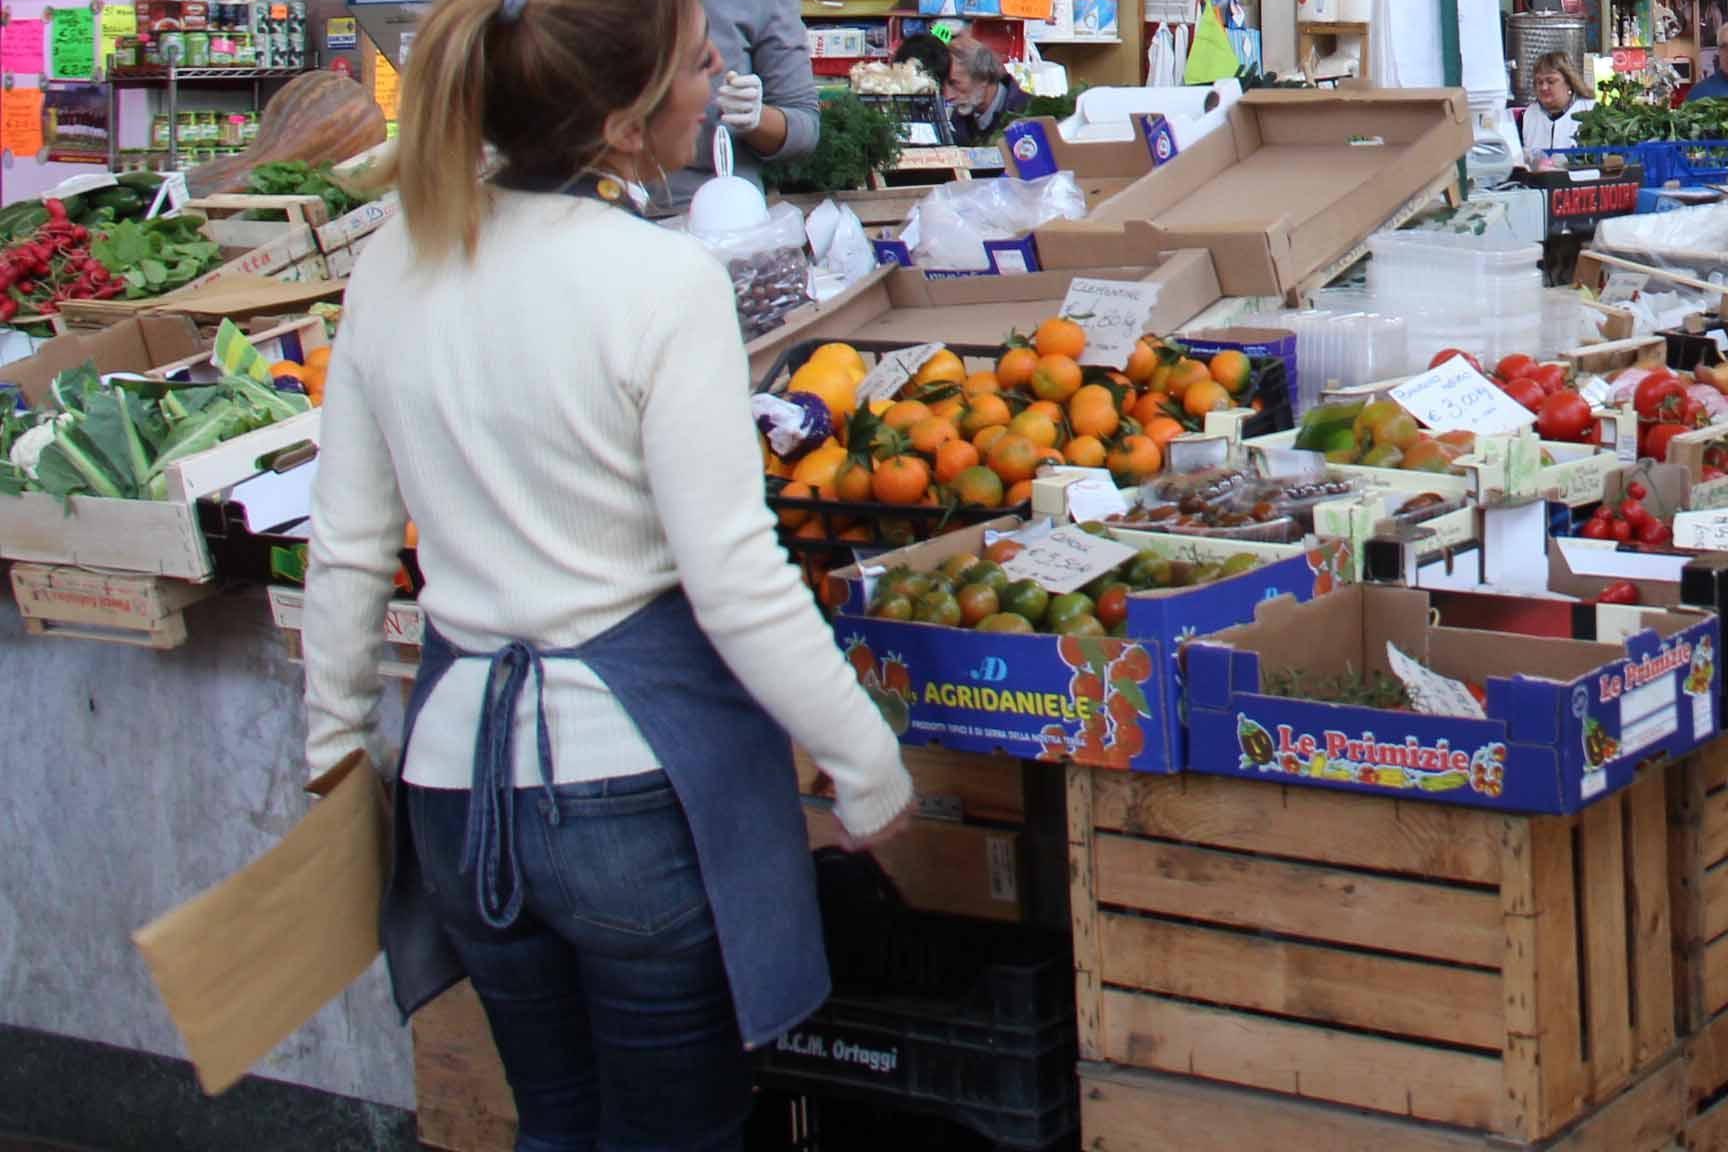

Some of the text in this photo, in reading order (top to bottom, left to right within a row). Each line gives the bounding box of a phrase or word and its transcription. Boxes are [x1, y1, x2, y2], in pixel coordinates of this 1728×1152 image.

[923, 682, 1092, 720] AGRIDANIELE
[1277, 724, 1469, 772] Le Primizie
[832, 1039, 897, 1072] Ortaggi
